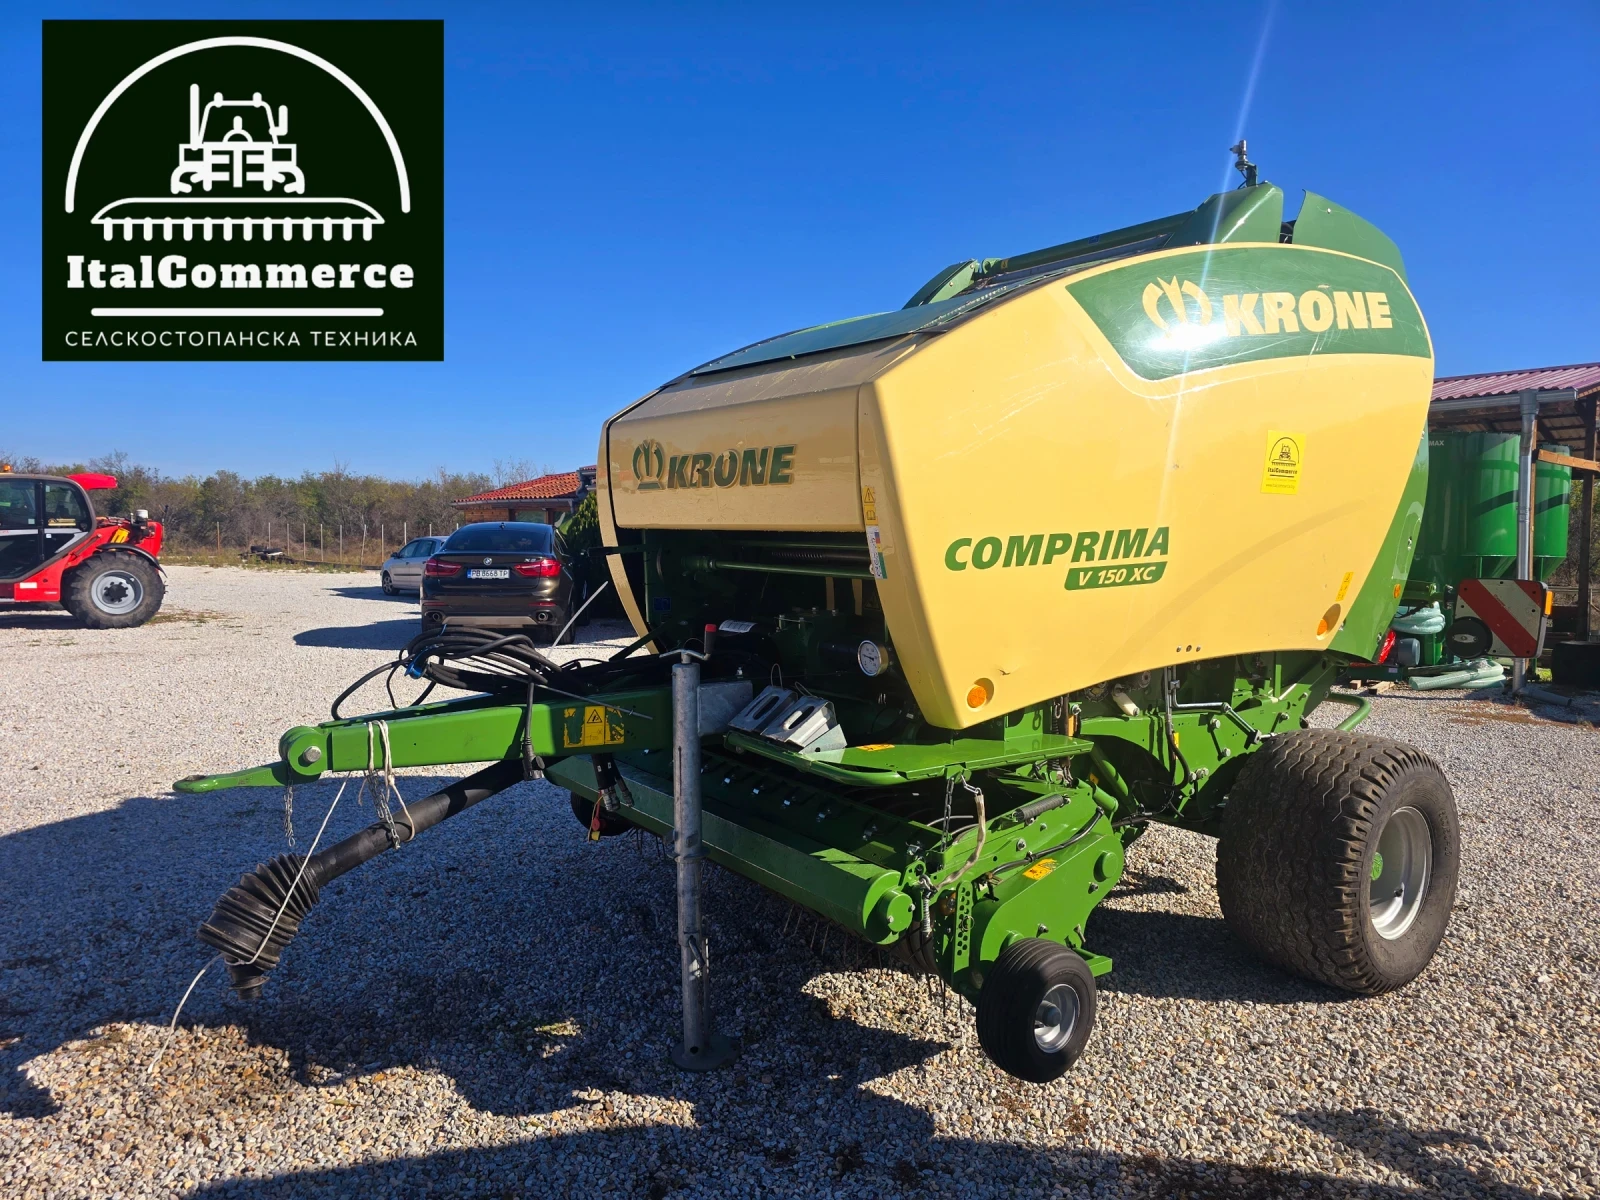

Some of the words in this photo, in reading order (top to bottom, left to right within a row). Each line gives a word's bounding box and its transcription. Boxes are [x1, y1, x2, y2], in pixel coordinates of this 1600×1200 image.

[1222, 290, 1393, 337] KRONE
[666, 445, 797, 490] KRONE
[944, 526, 1170, 572] COMPRIMA
[482, 569, 498, 577] 8668
[499, 569, 508, 577] TP
[1078, 571, 1093, 586] V
[1097, 568, 1127, 584] 150
[1129, 566, 1157, 582] XC
